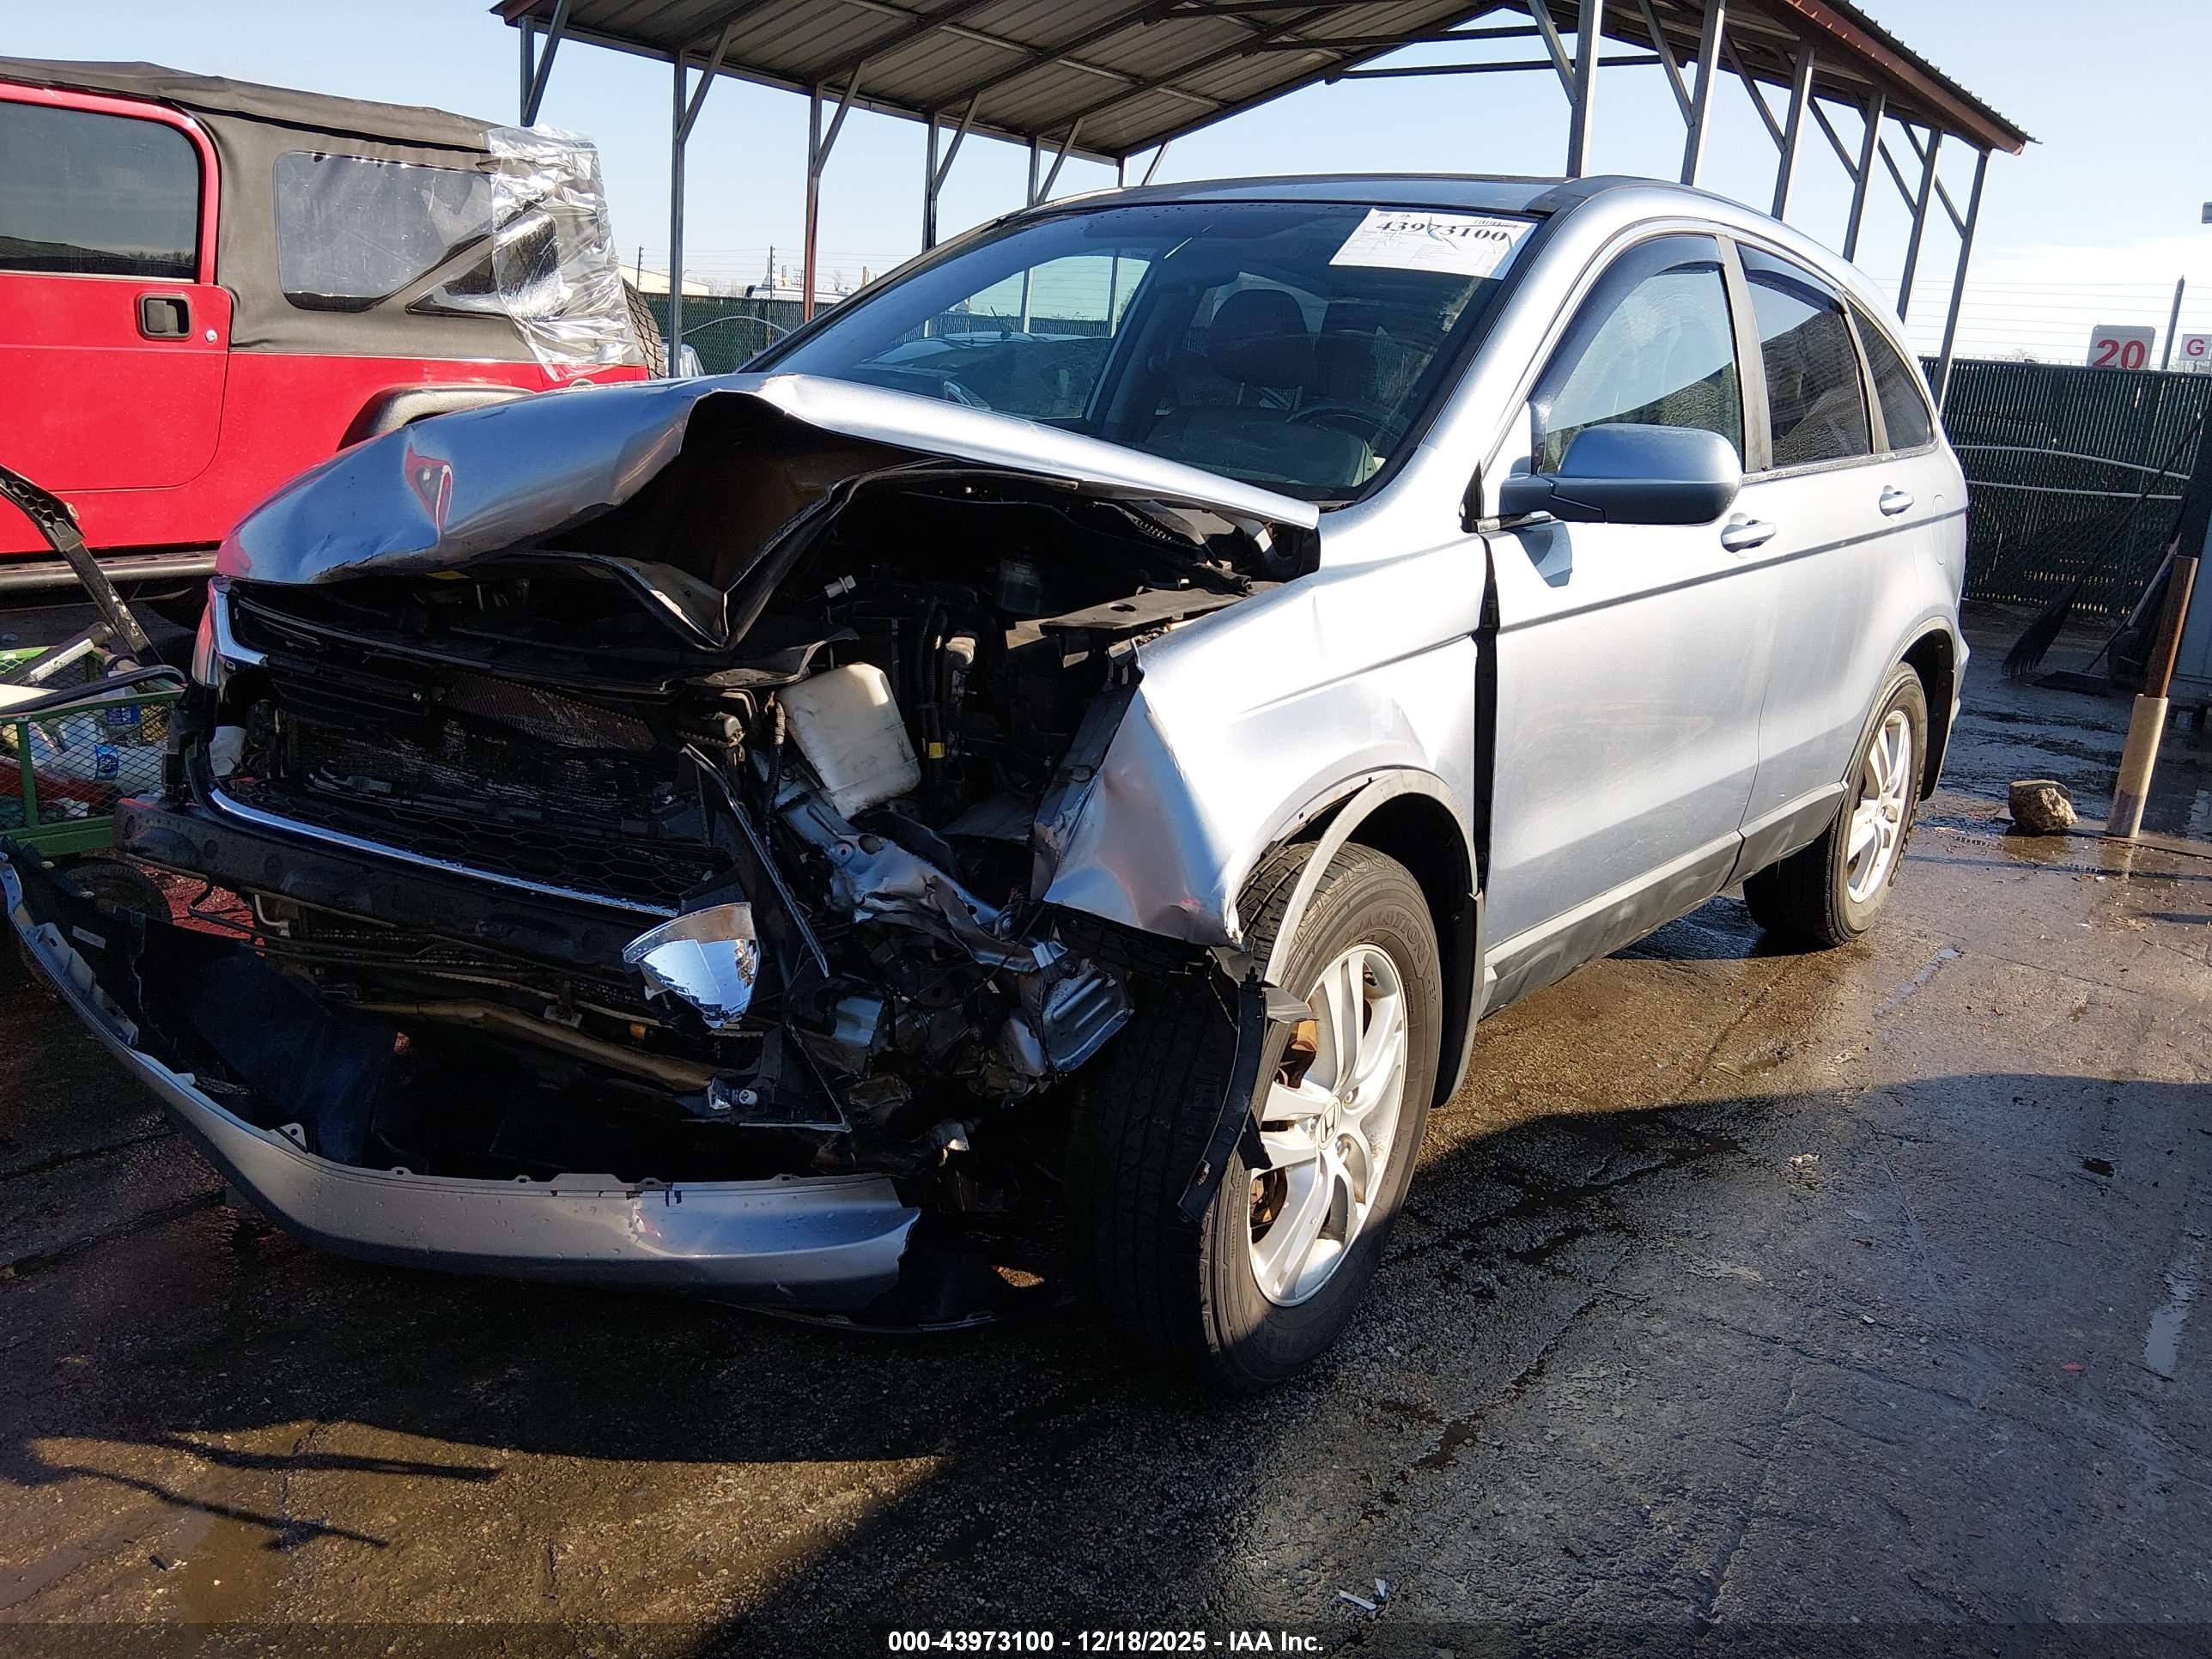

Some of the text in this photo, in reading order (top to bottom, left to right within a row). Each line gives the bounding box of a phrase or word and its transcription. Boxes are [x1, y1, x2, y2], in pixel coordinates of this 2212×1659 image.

[1376, 222, 1508, 240] 43973100
[2093, 338, 2146, 370] 20
[2186, 338, 2205, 356] G
